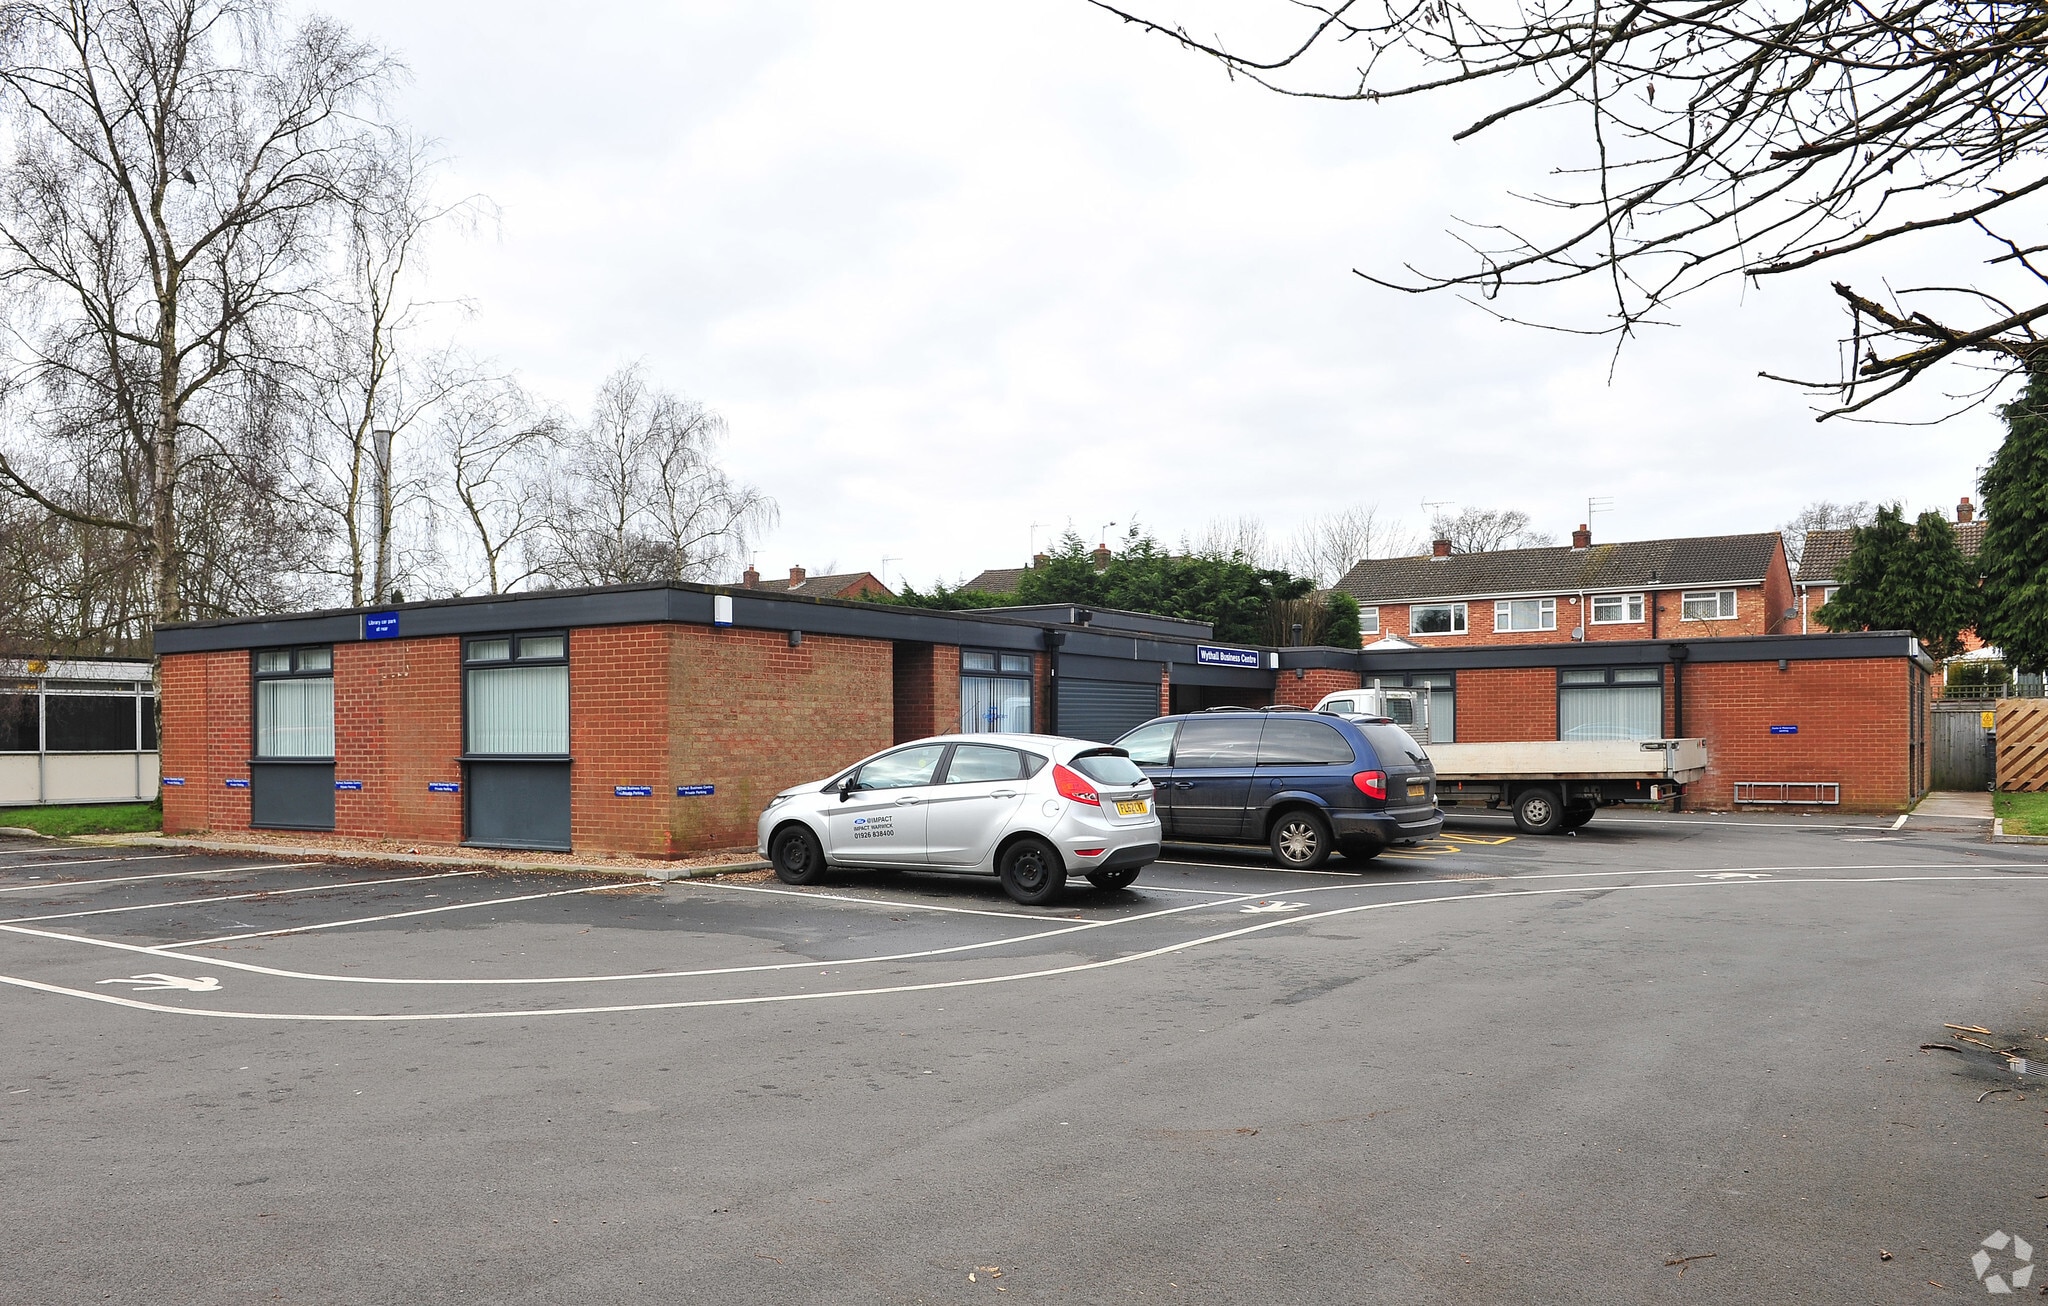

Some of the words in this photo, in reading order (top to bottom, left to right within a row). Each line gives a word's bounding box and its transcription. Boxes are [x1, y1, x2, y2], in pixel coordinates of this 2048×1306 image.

[1200, 649, 1220, 661] Wythall
[1220, 651, 1241, 662] Business
[1241, 653, 1257, 664] Centre
[854, 831, 871, 839] 01926
[872, 829, 894, 838] 838400
